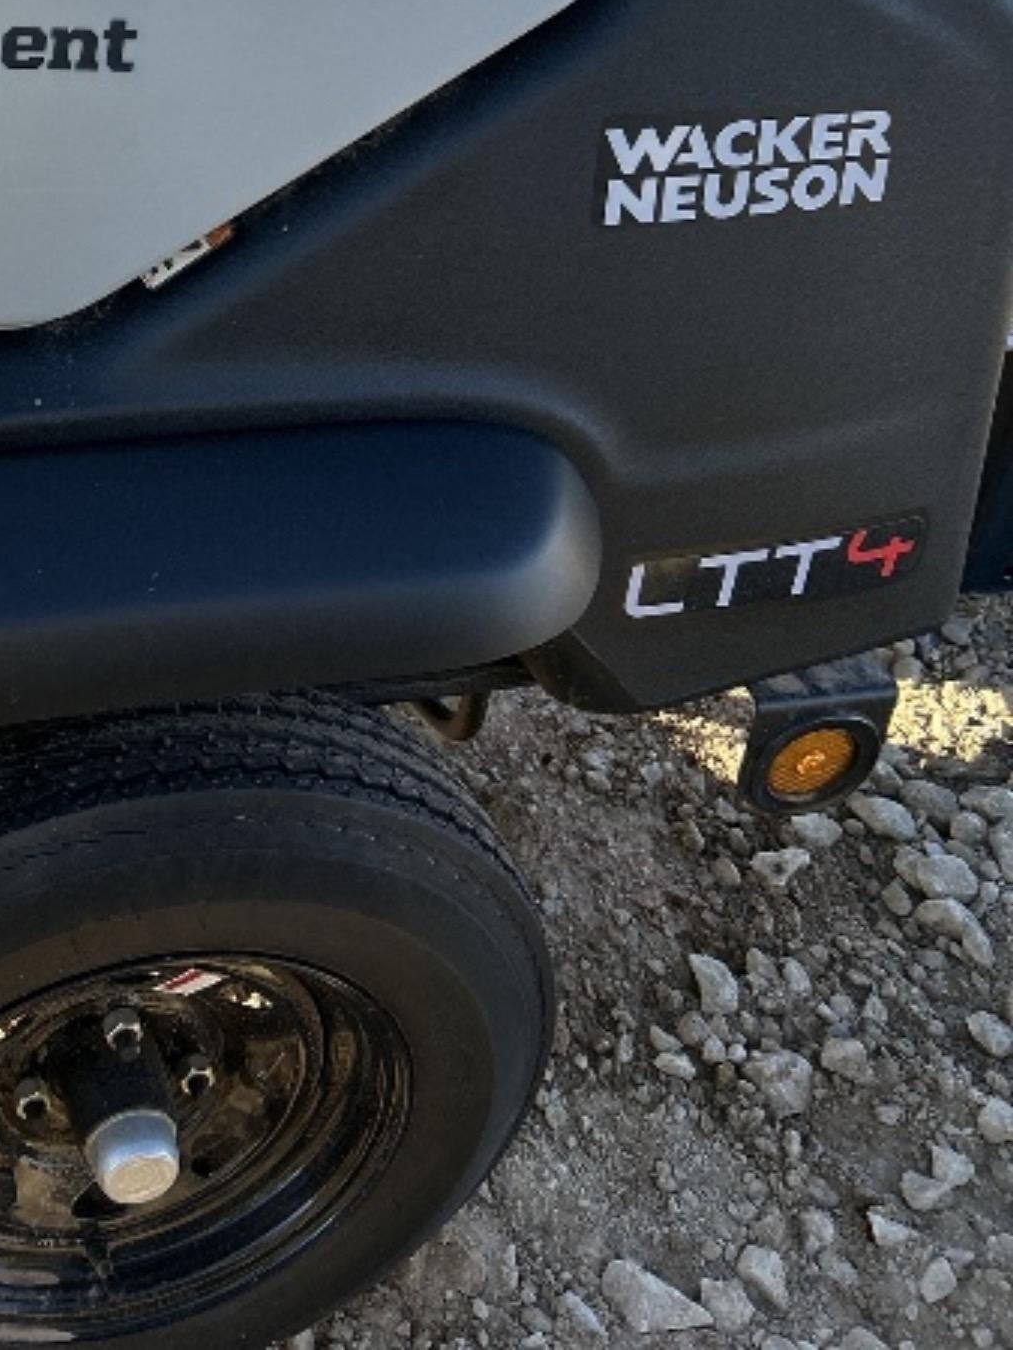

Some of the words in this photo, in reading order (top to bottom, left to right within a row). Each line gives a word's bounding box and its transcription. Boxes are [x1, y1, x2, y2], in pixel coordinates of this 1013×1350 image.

[604, 109, 891, 175] WACKER
[603, 158, 888, 226] NEUSON
[624, 530, 914, 618] LTT4
